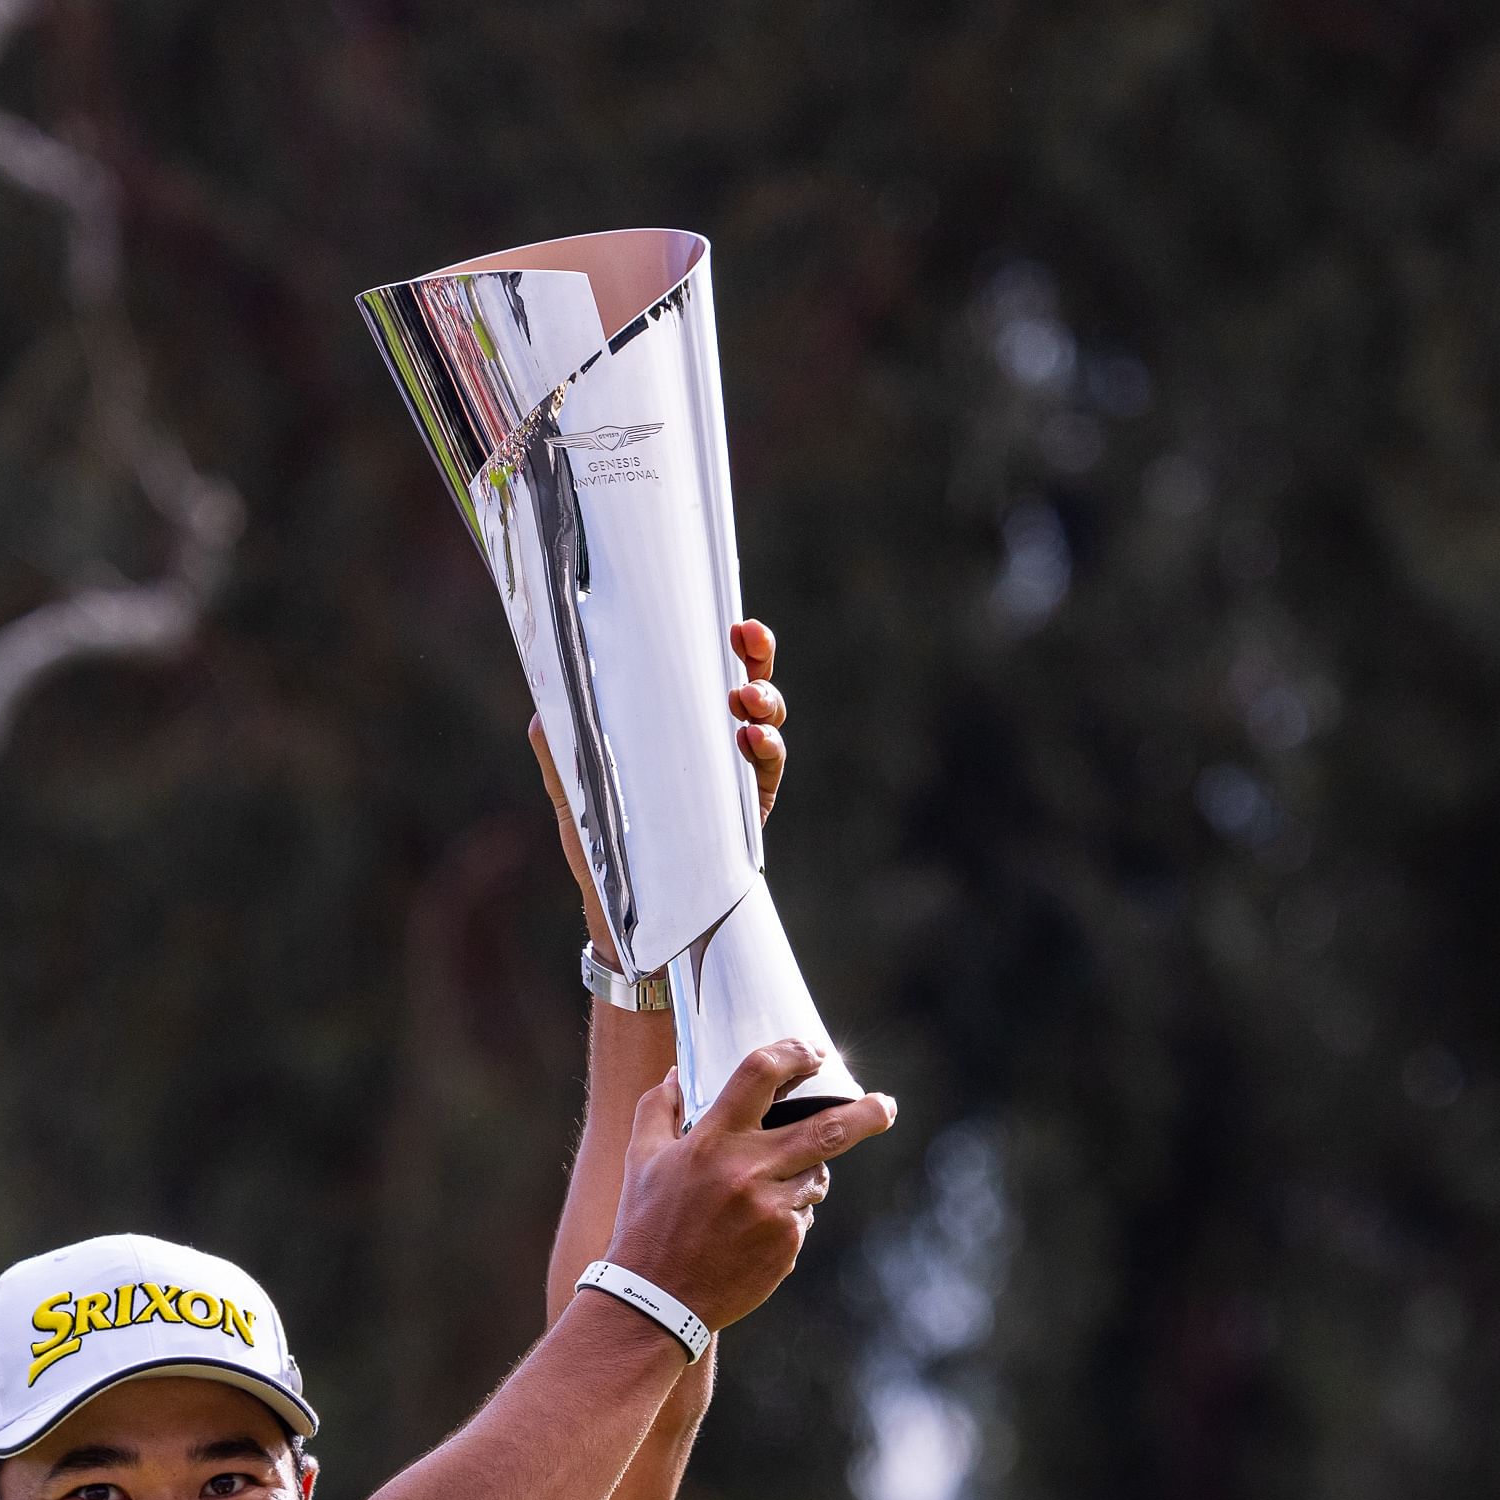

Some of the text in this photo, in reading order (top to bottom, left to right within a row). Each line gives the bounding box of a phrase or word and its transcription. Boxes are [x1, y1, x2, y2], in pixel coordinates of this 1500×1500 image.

[588, 456, 641, 472] GENESIS
[574, 469, 659, 488] INVITATIONAL
[28, 1281, 257, 1388] SRIXON
